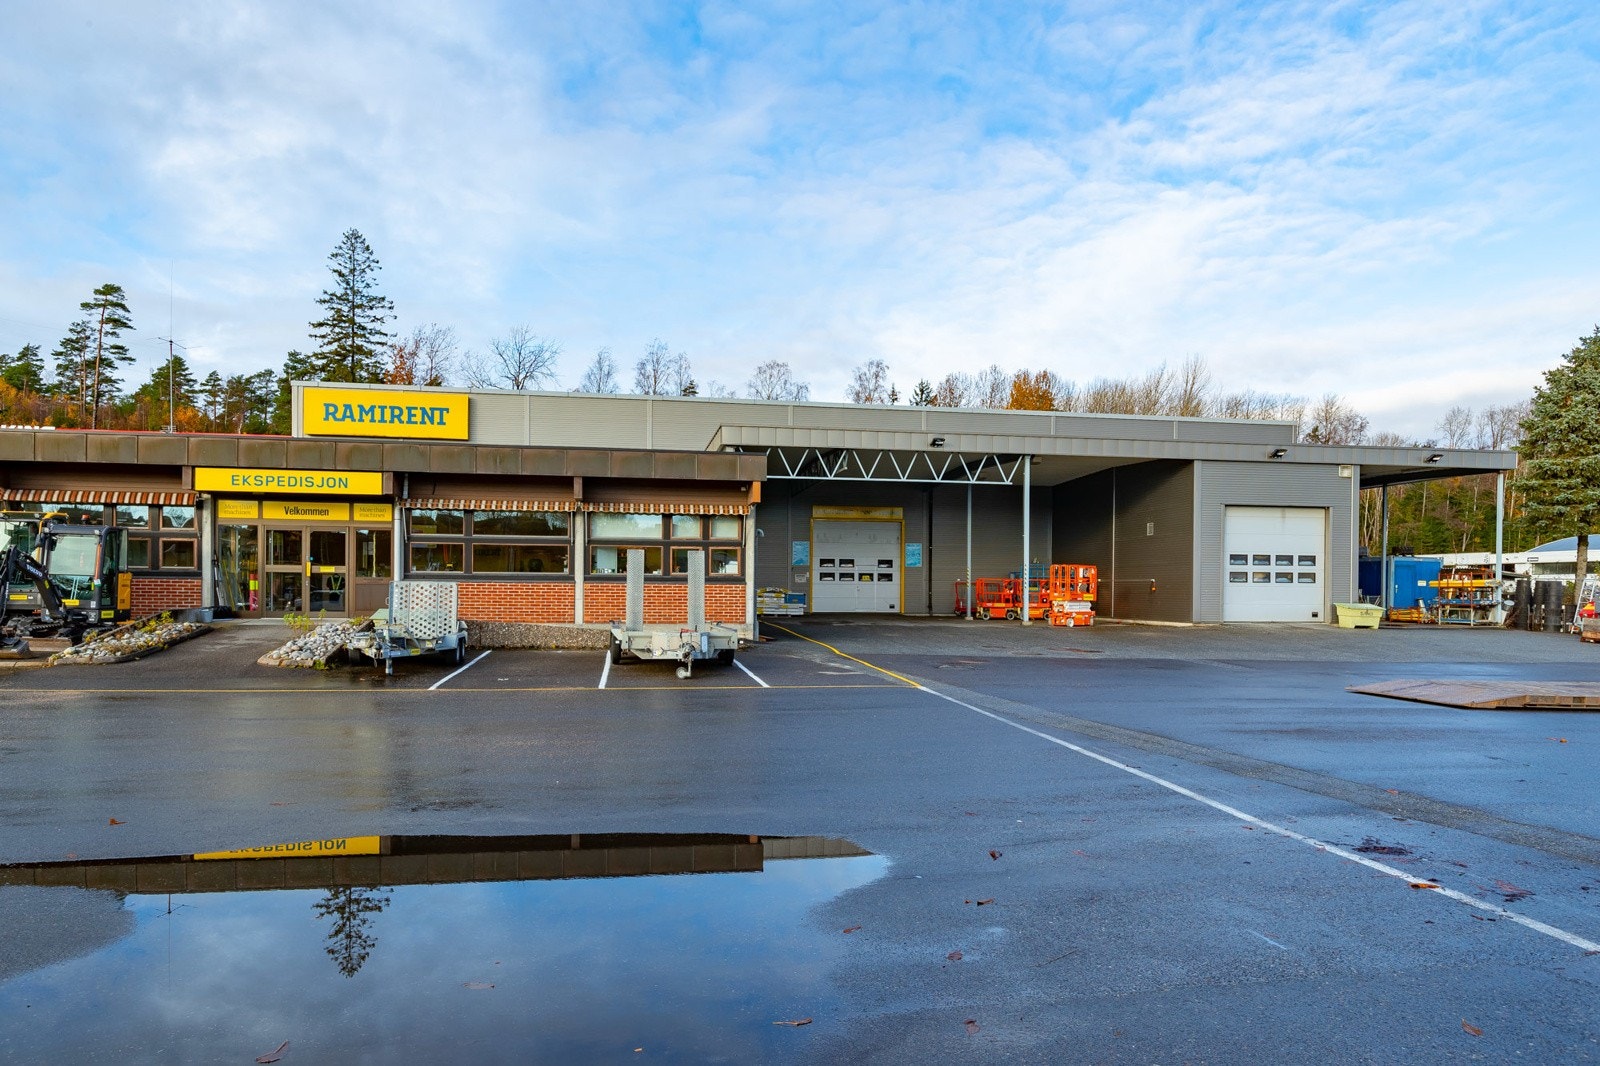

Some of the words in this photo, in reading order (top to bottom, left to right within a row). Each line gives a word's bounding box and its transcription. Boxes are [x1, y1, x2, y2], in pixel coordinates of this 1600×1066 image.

[323, 403, 450, 426] RAMIRENT
[231, 474, 348, 489] EKSPEDISJON
[284, 505, 329, 517] Velkommen
